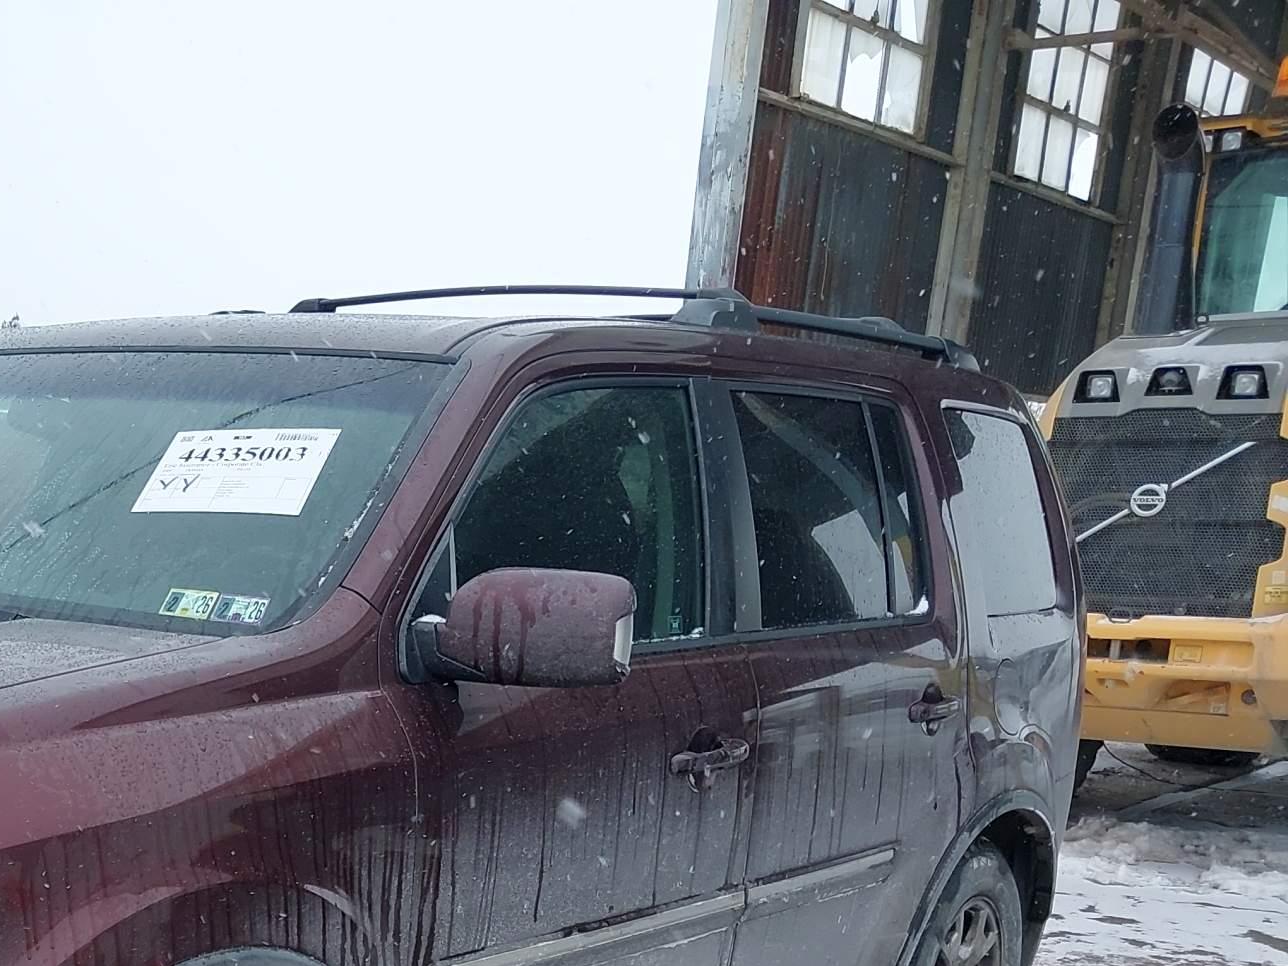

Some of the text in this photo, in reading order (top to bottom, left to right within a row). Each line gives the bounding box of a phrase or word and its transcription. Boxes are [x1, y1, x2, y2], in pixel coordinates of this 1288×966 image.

[178, 446, 309, 463] 44335003
[195, 595, 214, 614] 26
[247, 601, 266, 620] 26
